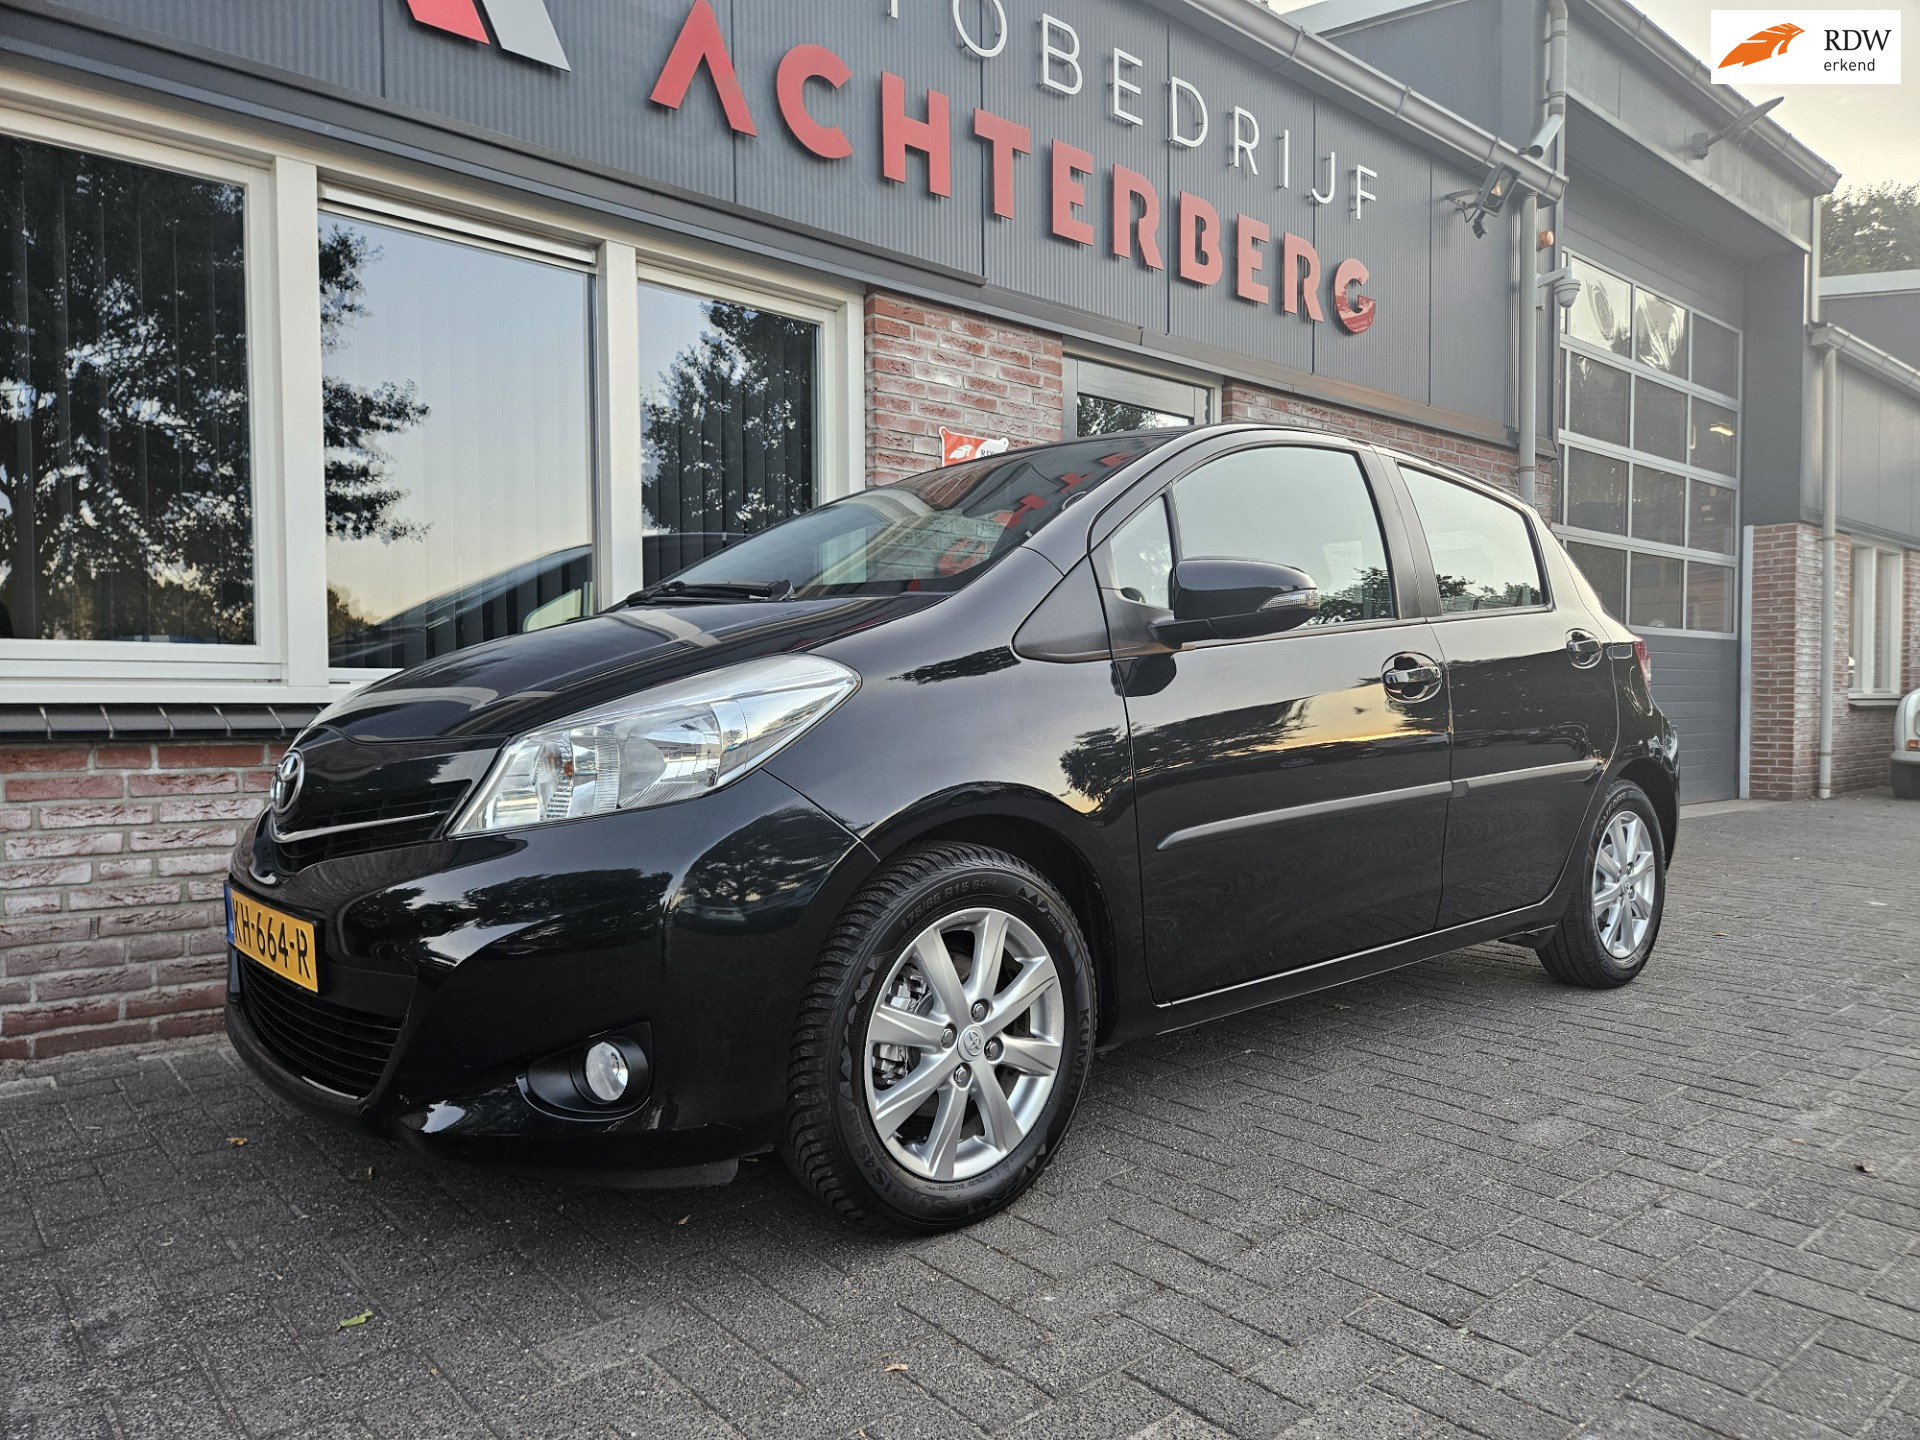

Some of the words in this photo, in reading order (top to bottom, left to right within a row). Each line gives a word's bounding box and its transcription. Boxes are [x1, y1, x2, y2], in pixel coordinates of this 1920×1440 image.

[648, 0, 1377, 335] ACHTERBERG
[888, 0, 1378, 220] OBEDRIJF
[232, 898, 311, 979] KH-664-R
